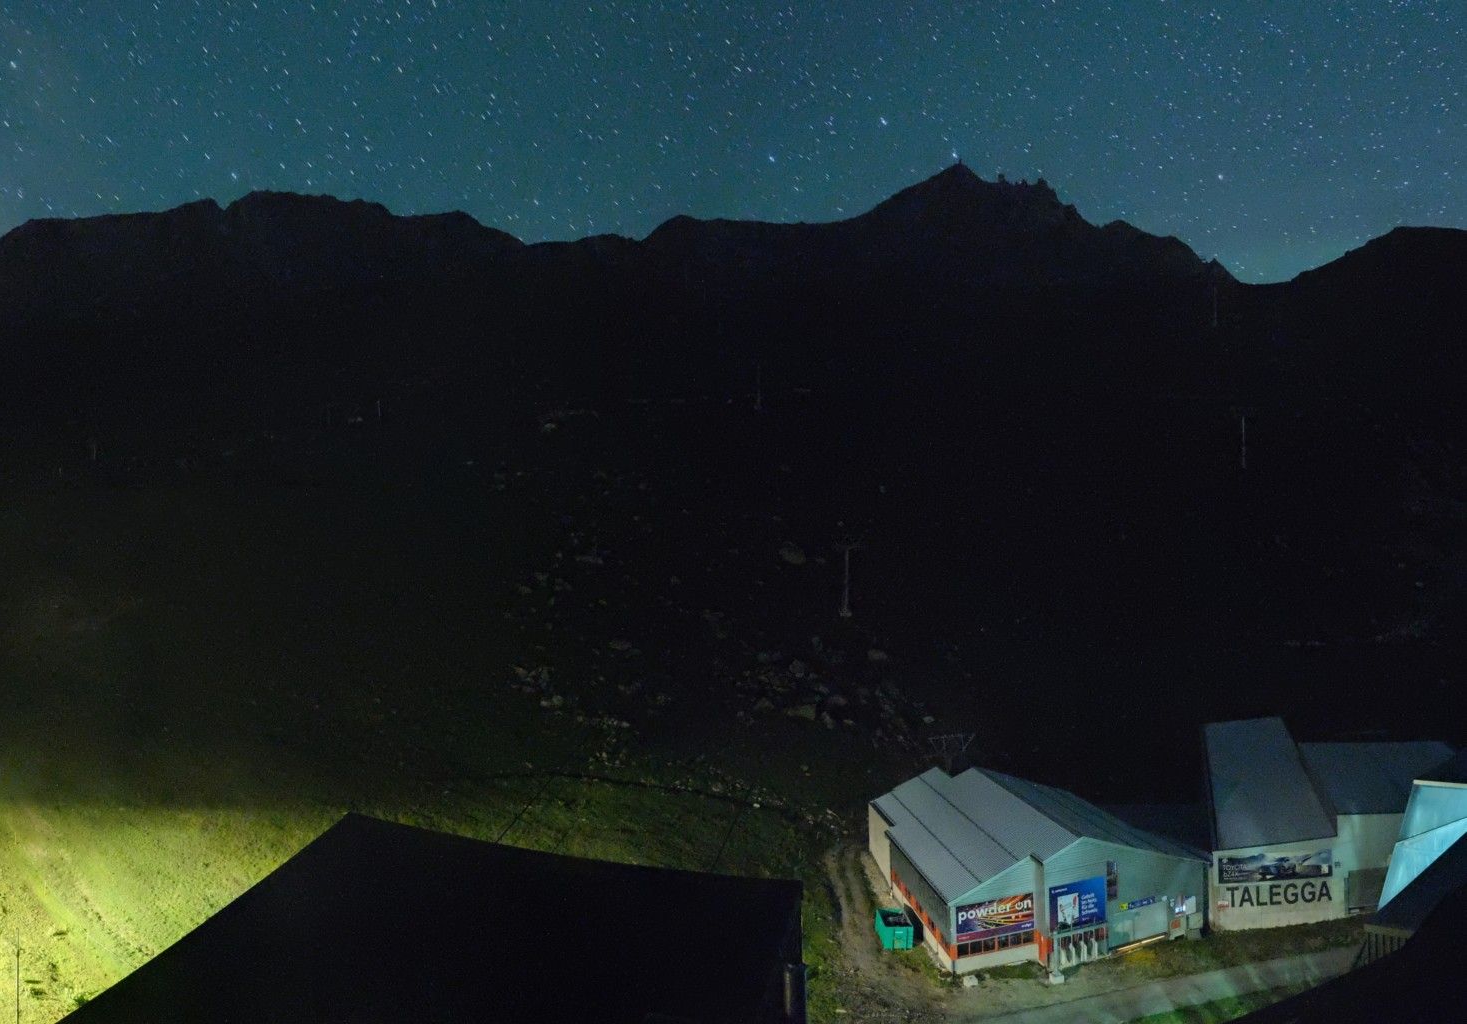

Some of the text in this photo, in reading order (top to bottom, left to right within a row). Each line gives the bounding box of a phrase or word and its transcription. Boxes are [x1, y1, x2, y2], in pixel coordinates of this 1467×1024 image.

[1226, 880, 1333, 908] TALEGGA
[958, 899, 1032, 924] powder on
